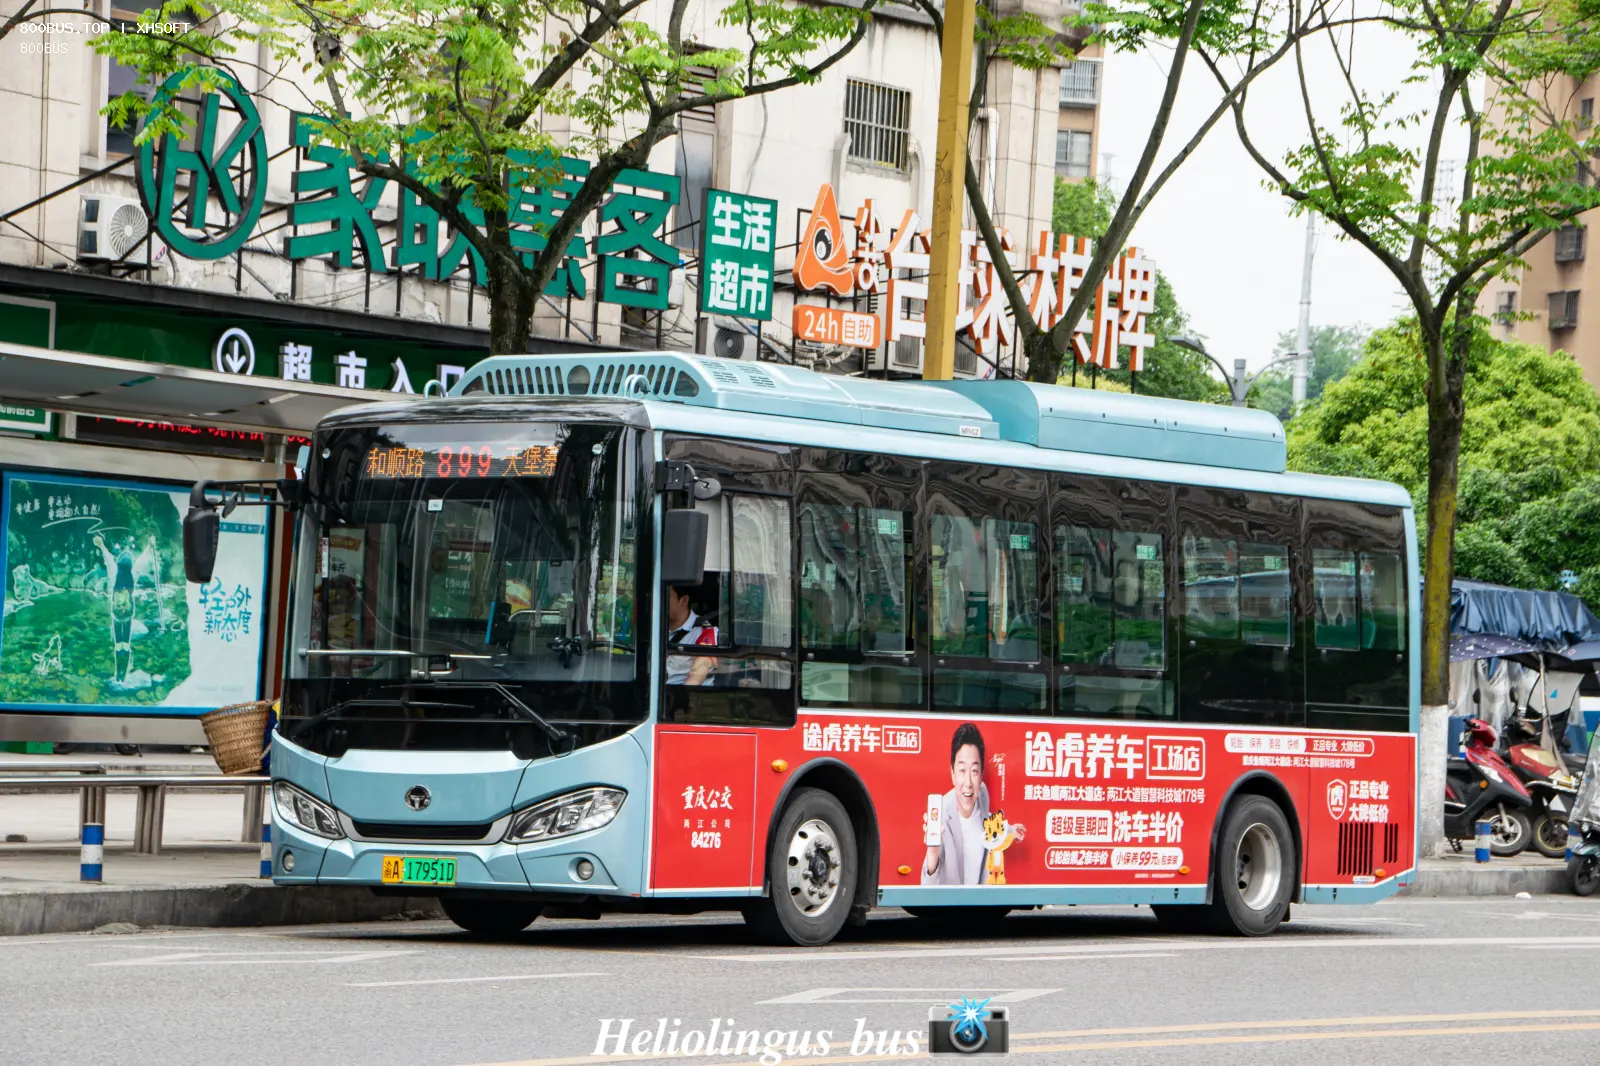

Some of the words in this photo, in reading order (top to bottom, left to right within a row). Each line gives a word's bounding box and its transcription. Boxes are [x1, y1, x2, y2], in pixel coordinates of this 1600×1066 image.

[711, 195, 771, 252] 生活
[708, 259, 769, 314] 超市
[804, 310, 838, 341] 24h
[844, 317, 872, 342] 自助
[367, 447, 425, 478] 和顺路
[437, 446, 492, 478] 899
[803, 722, 881, 752] 途虎养车
[886, 731, 918, 748] 工场店
[1025, 731, 1144, 779] 途虎养车
[1151, 744, 1200, 771] 工场店
[681, 785, 733, 809] 重庆公交
[1330, 785, 1344, 806] 虎
[1349, 780, 1389, 800] 正品专业
[1051, 816, 1108, 836] 超级星期四
[1113, 811, 1184, 843] 洗车半价
[1348, 803, 1389, 823] 大牌低价
[691, 831, 721, 848] 84276
